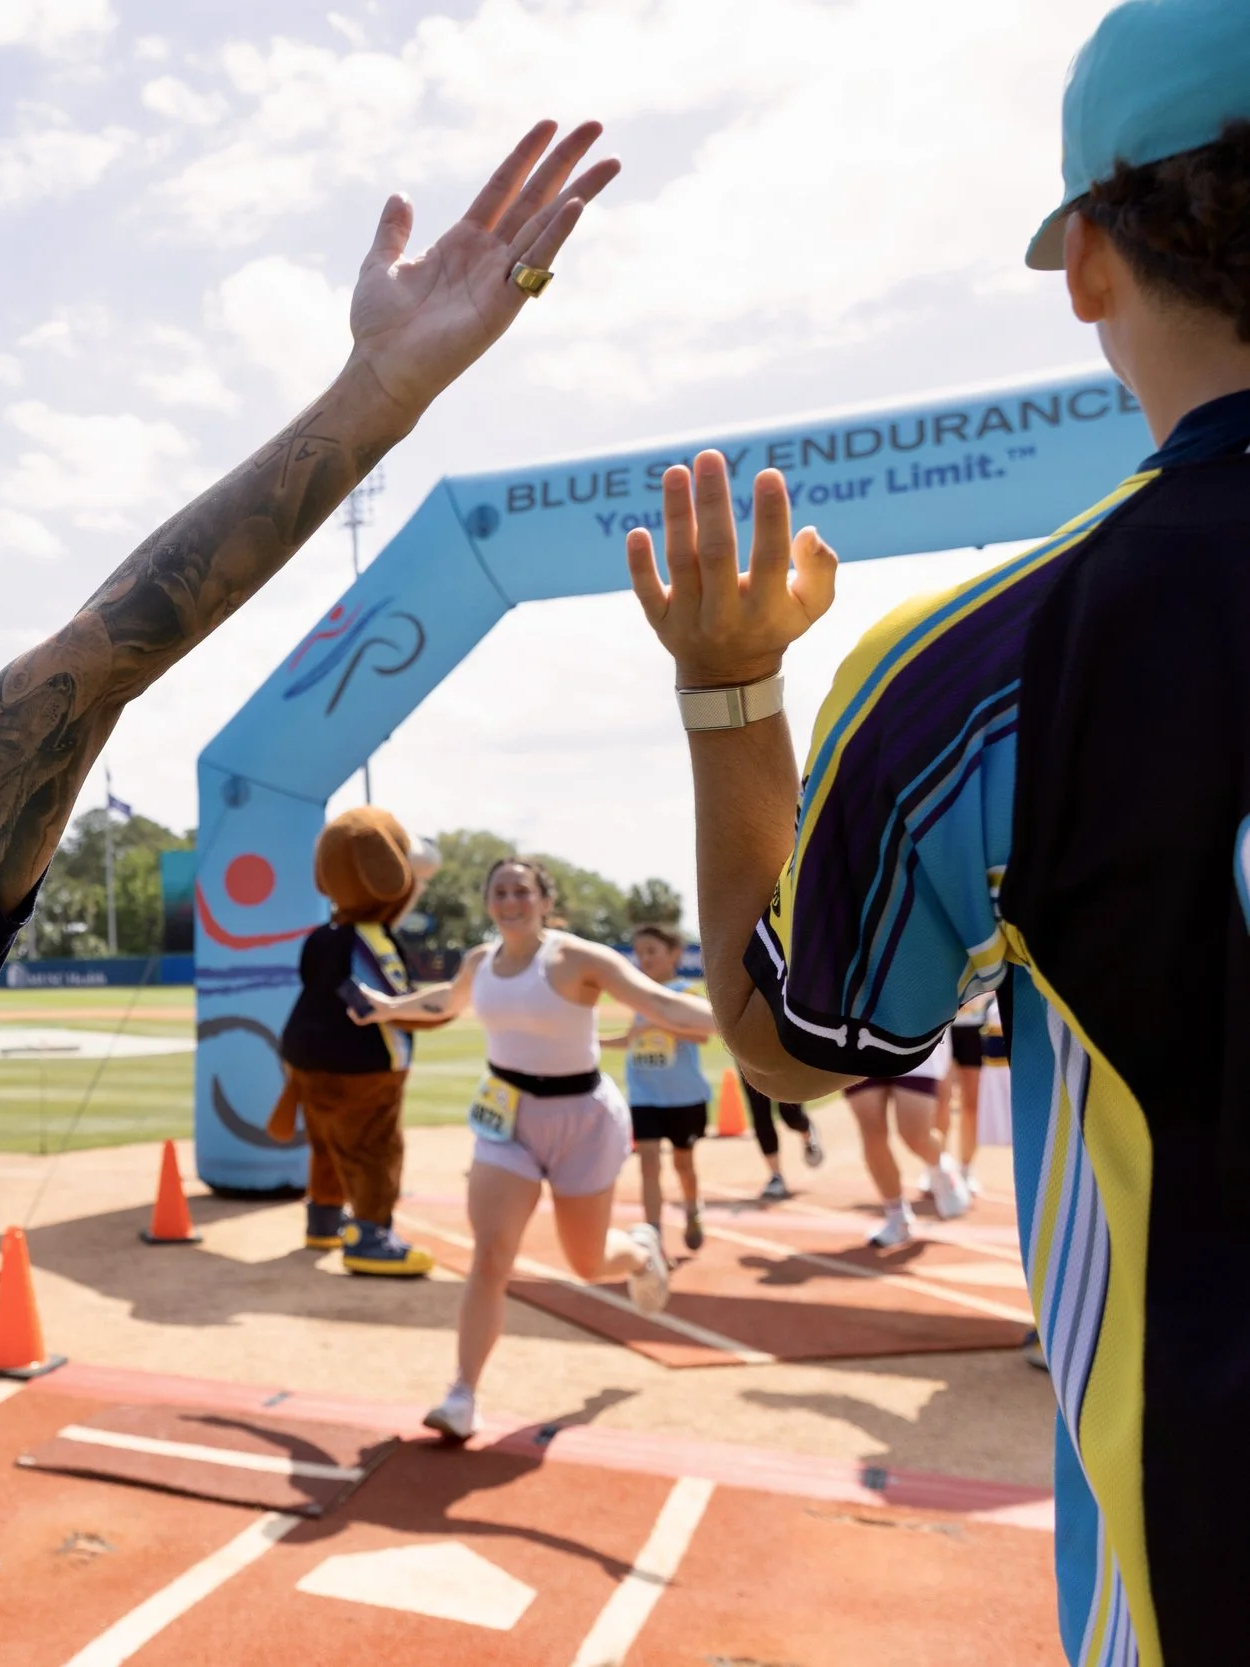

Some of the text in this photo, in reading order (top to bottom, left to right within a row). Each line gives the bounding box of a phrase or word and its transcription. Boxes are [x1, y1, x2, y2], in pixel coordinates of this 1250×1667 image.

[507, 384, 1143, 514] BLUE SY ENDURANCE
[595, 509, 663, 538] You
[787, 476, 875, 508] Your
